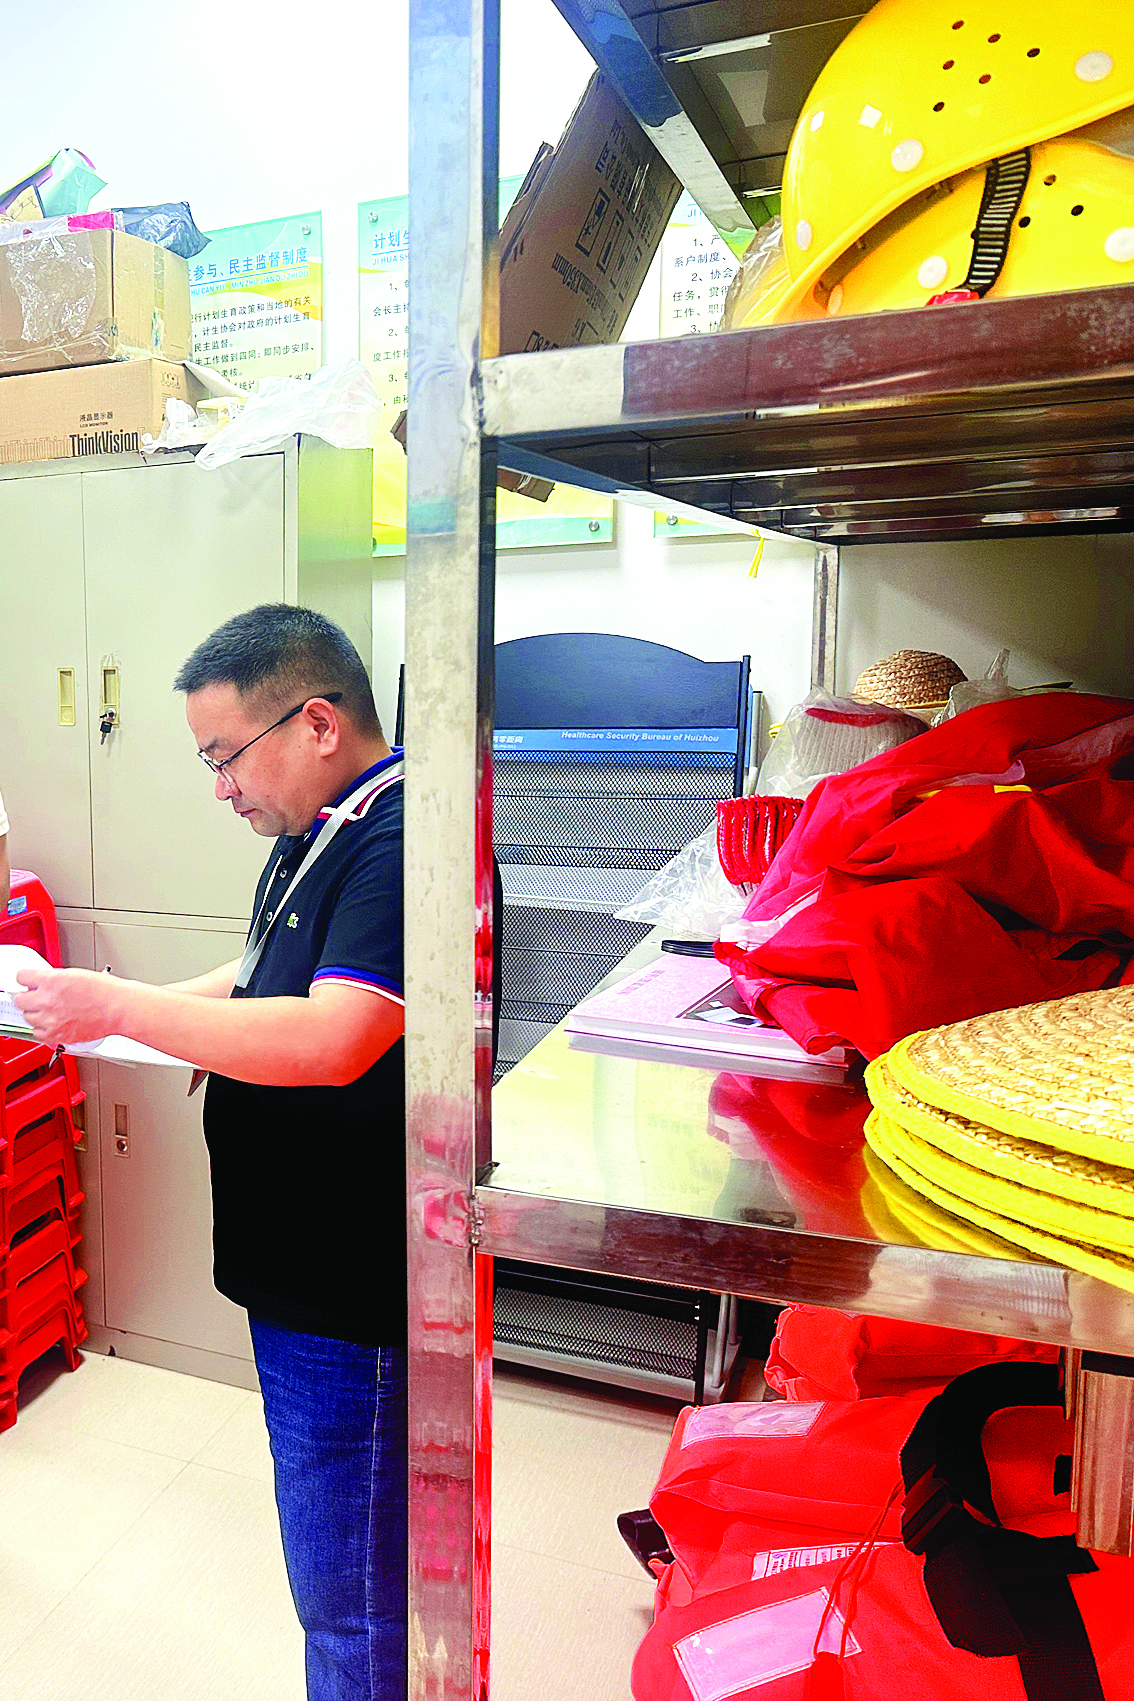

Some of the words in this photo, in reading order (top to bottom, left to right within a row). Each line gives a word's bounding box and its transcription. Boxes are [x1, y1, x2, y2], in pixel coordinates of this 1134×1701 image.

[189, 246, 308, 281] 参与、民主监督制度
[380, 255, 398, 265] HUA
[79, 411, 114, 423] 液晶显示器
[69, 429, 139, 458] ThinkVision
[561, 731, 604, 740] Healthcare
[606, 731, 640, 742] Security
[642, 732, 671, 741] Bureau
[673, 733, 683, 741] of
[684, 734, 719, 743] Huizhou
